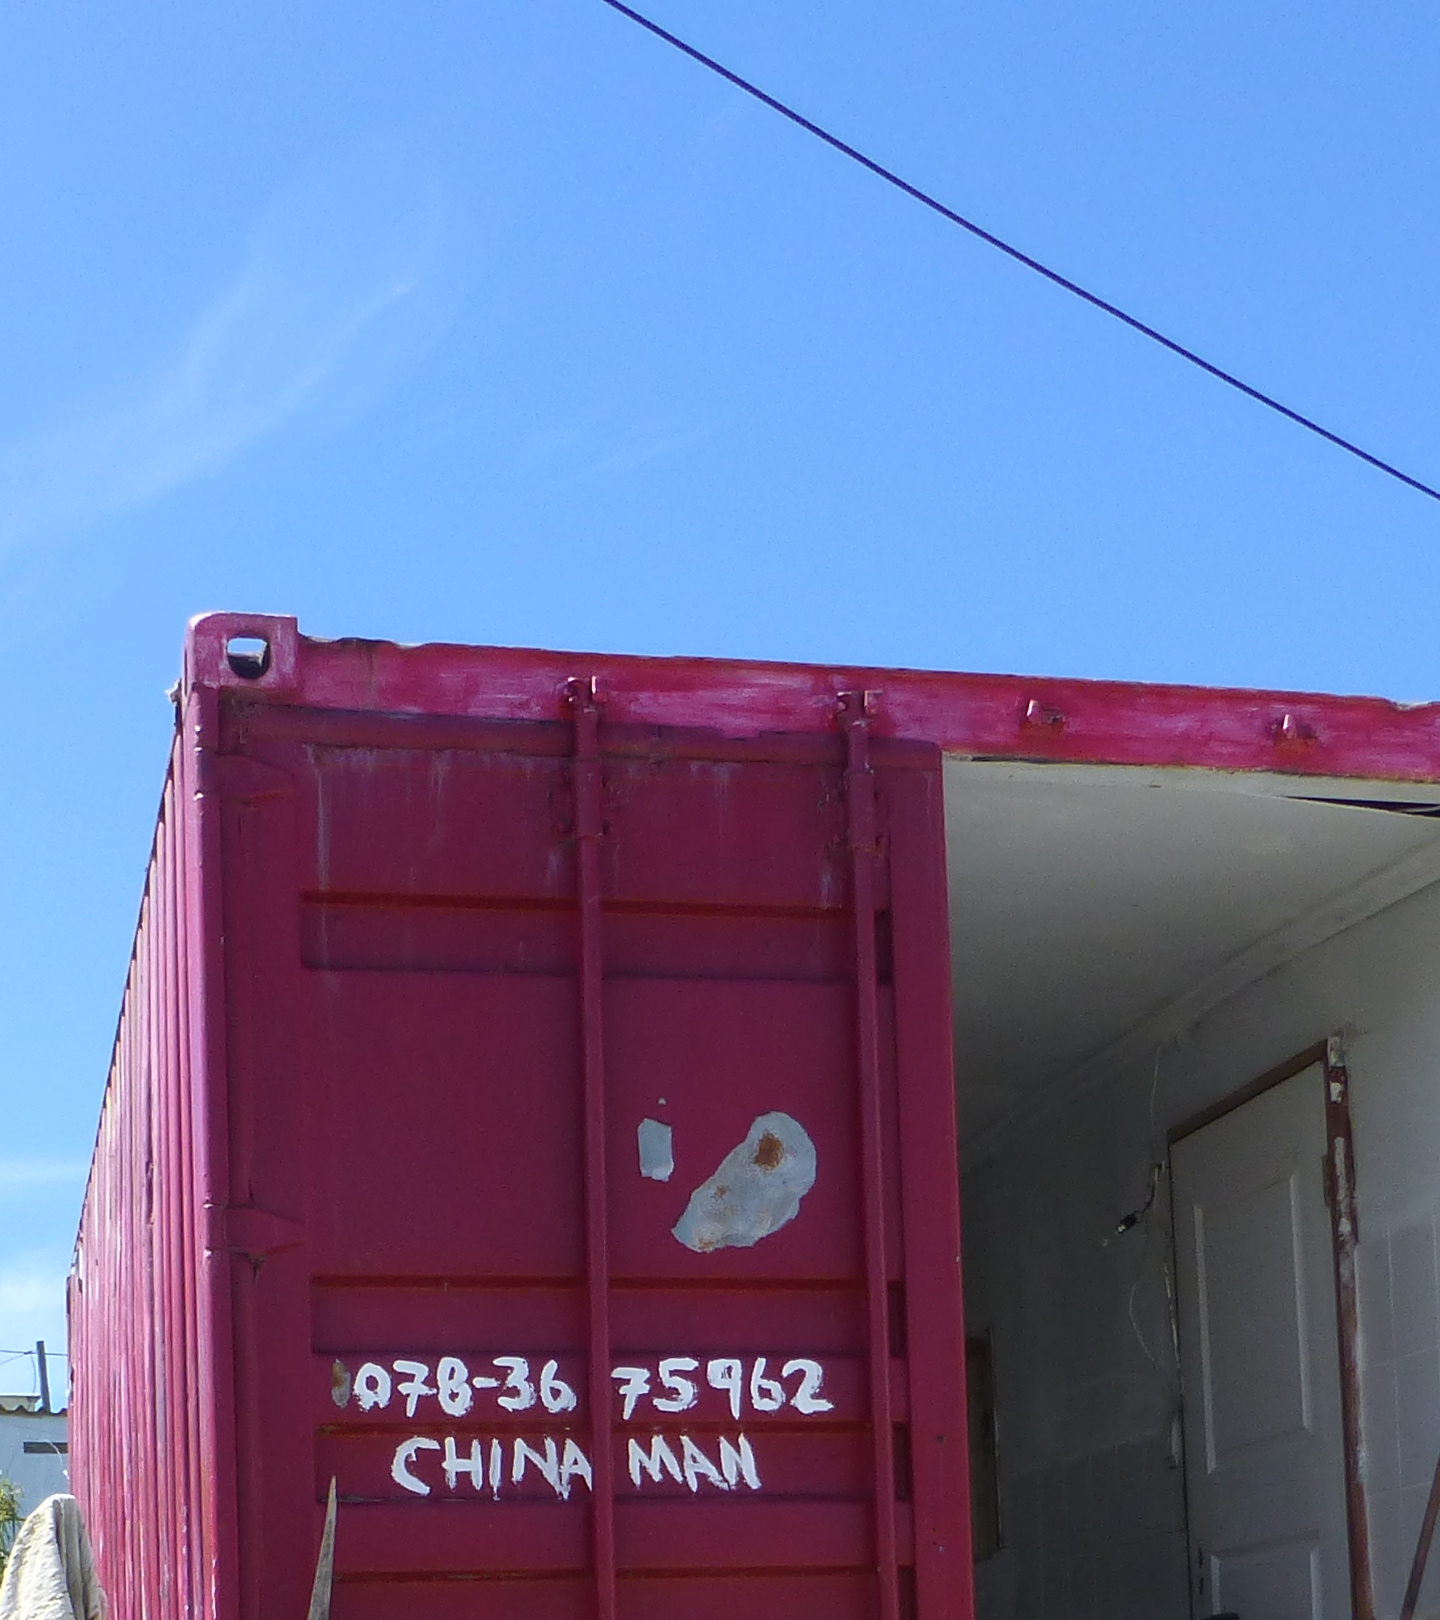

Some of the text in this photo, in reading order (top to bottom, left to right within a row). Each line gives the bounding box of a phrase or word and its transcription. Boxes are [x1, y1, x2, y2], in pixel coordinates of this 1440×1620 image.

[352, 1356, 836, 1420] 078-36 75962
[391, 1433, 763, 1501] CHINA MAN
